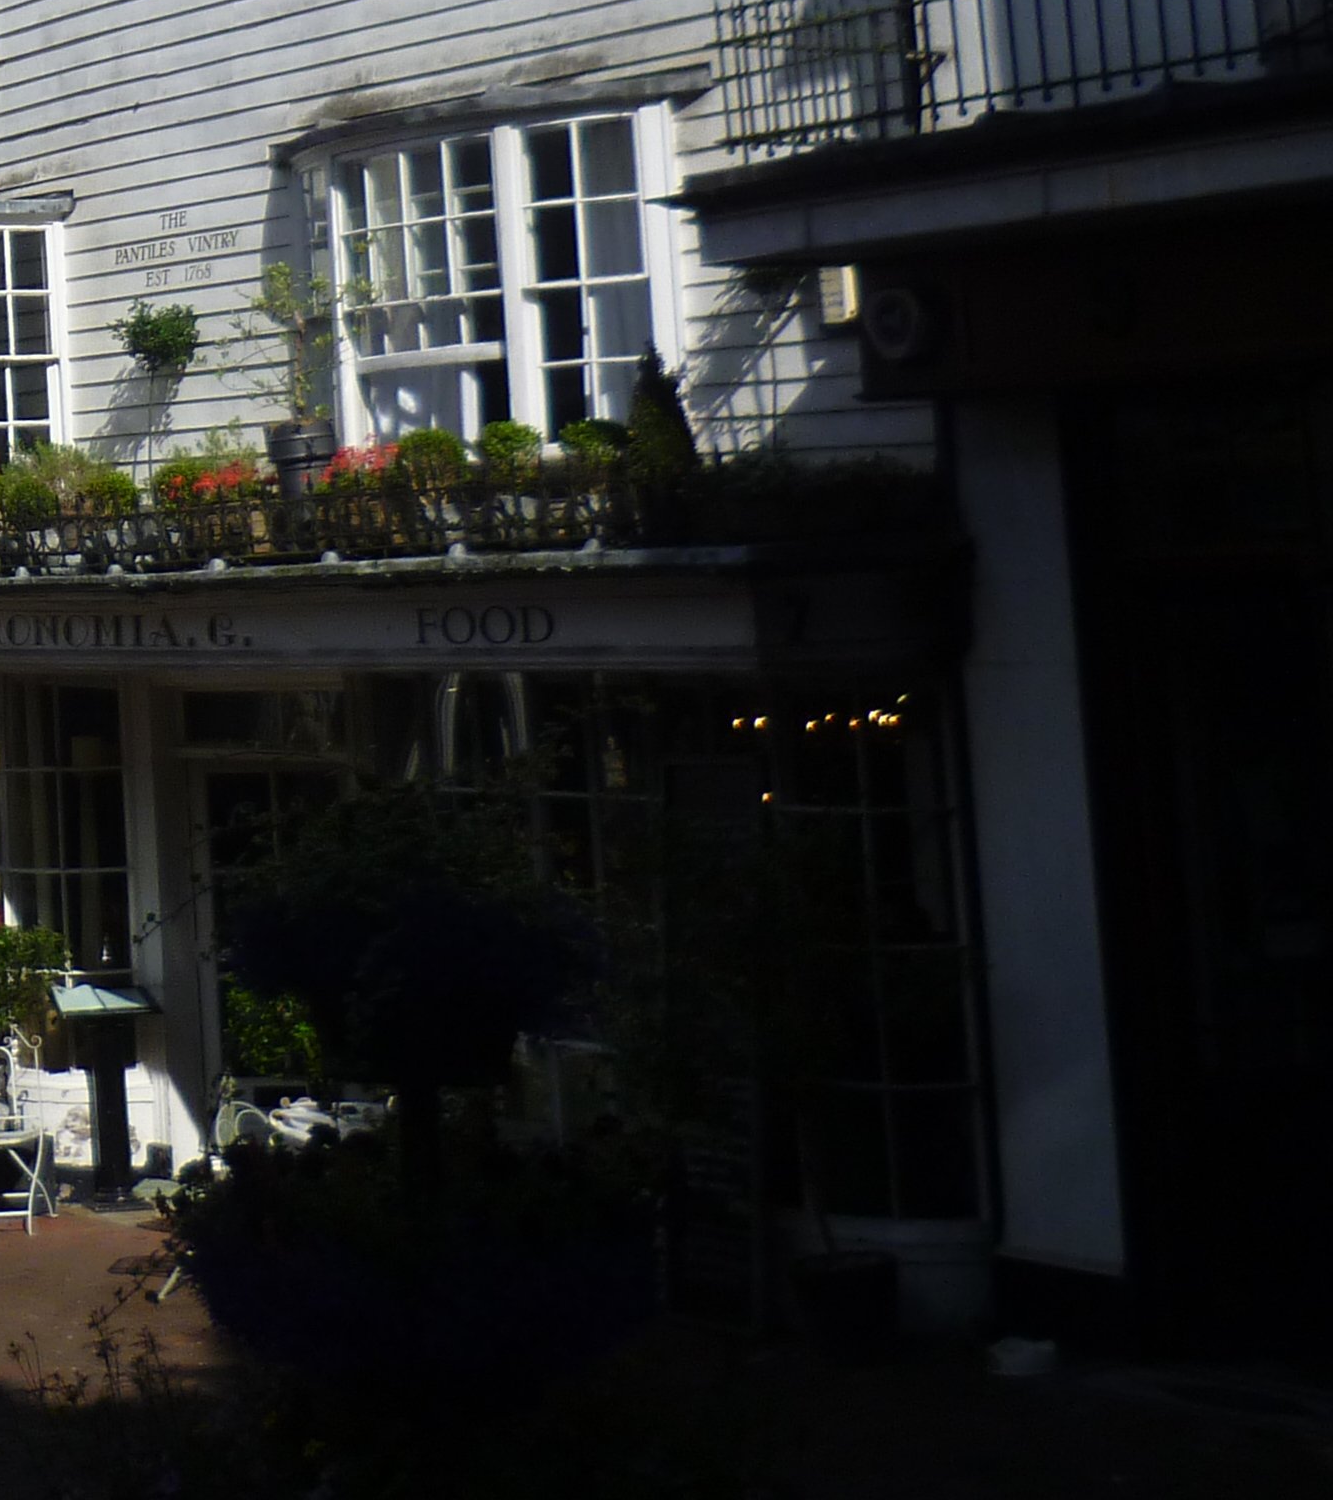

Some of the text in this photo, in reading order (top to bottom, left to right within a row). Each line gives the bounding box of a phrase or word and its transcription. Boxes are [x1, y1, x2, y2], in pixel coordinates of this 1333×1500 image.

[159, 211, 187, 230] THE
[114, 230, 239, 265] PANTILES VINTRY
[145, 263, 212, 287] EST 1768
[414, 604, 555, 646] FOOD
